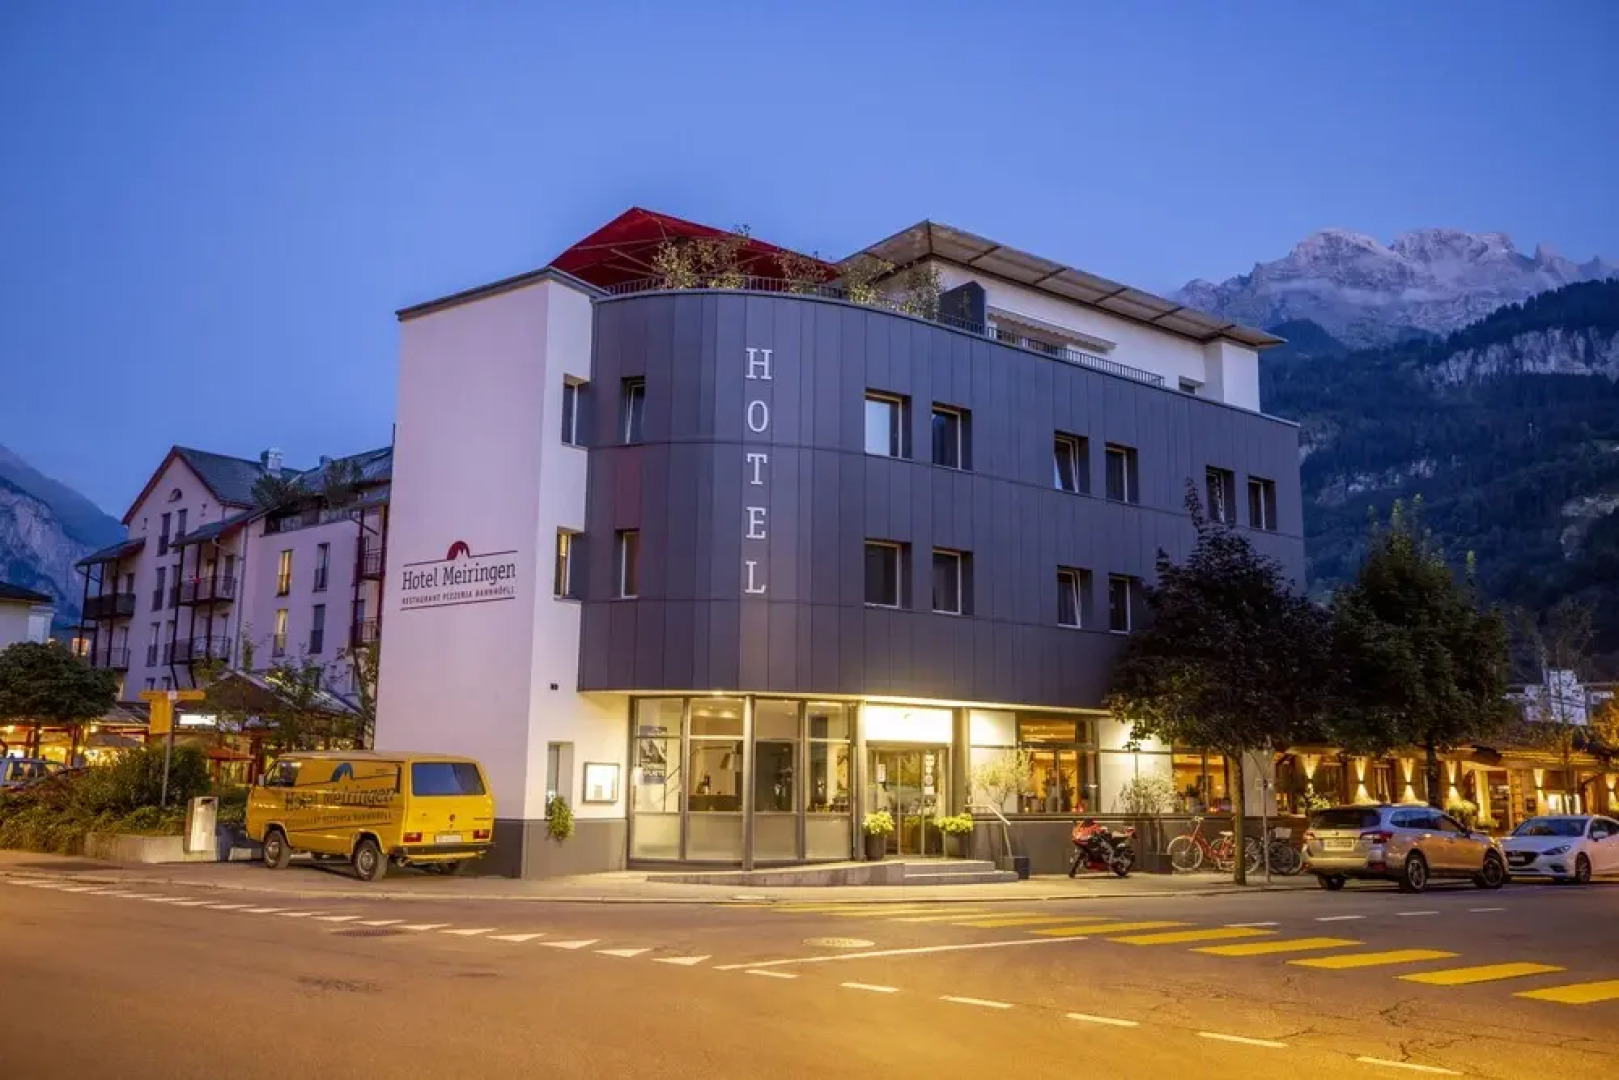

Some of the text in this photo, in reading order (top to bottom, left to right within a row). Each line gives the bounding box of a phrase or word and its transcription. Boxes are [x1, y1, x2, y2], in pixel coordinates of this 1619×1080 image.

[745, 348, 773, 594] HOTEL
[402, 562, 516, 590] Hotel Meiringen
